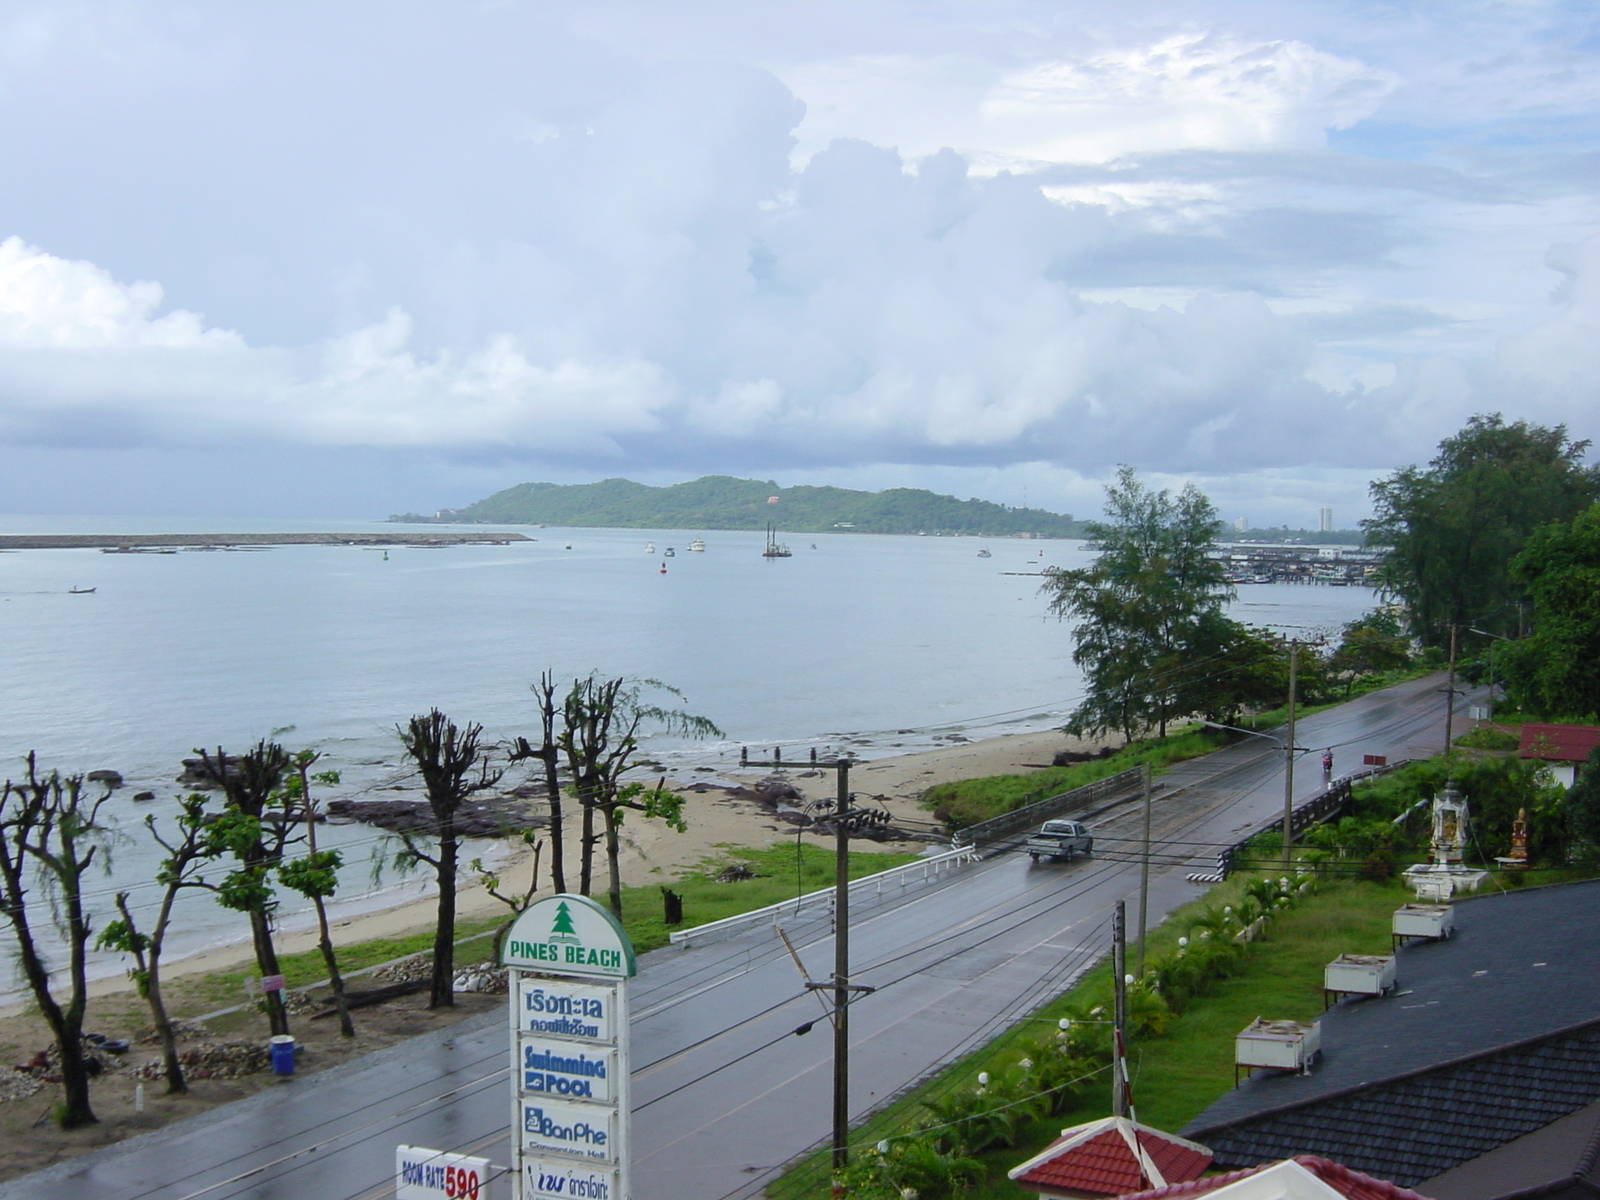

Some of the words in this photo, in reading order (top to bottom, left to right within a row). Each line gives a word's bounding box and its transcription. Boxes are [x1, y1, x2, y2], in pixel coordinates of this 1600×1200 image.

[510, 940, 558, 962] PINES
[565, 945, 621, 968] BEACH
[402, 1160, 423, 1187] ROOM
[425, 1164, 445, 1190] RATE
[445, 1165, 479, 1200] 590
